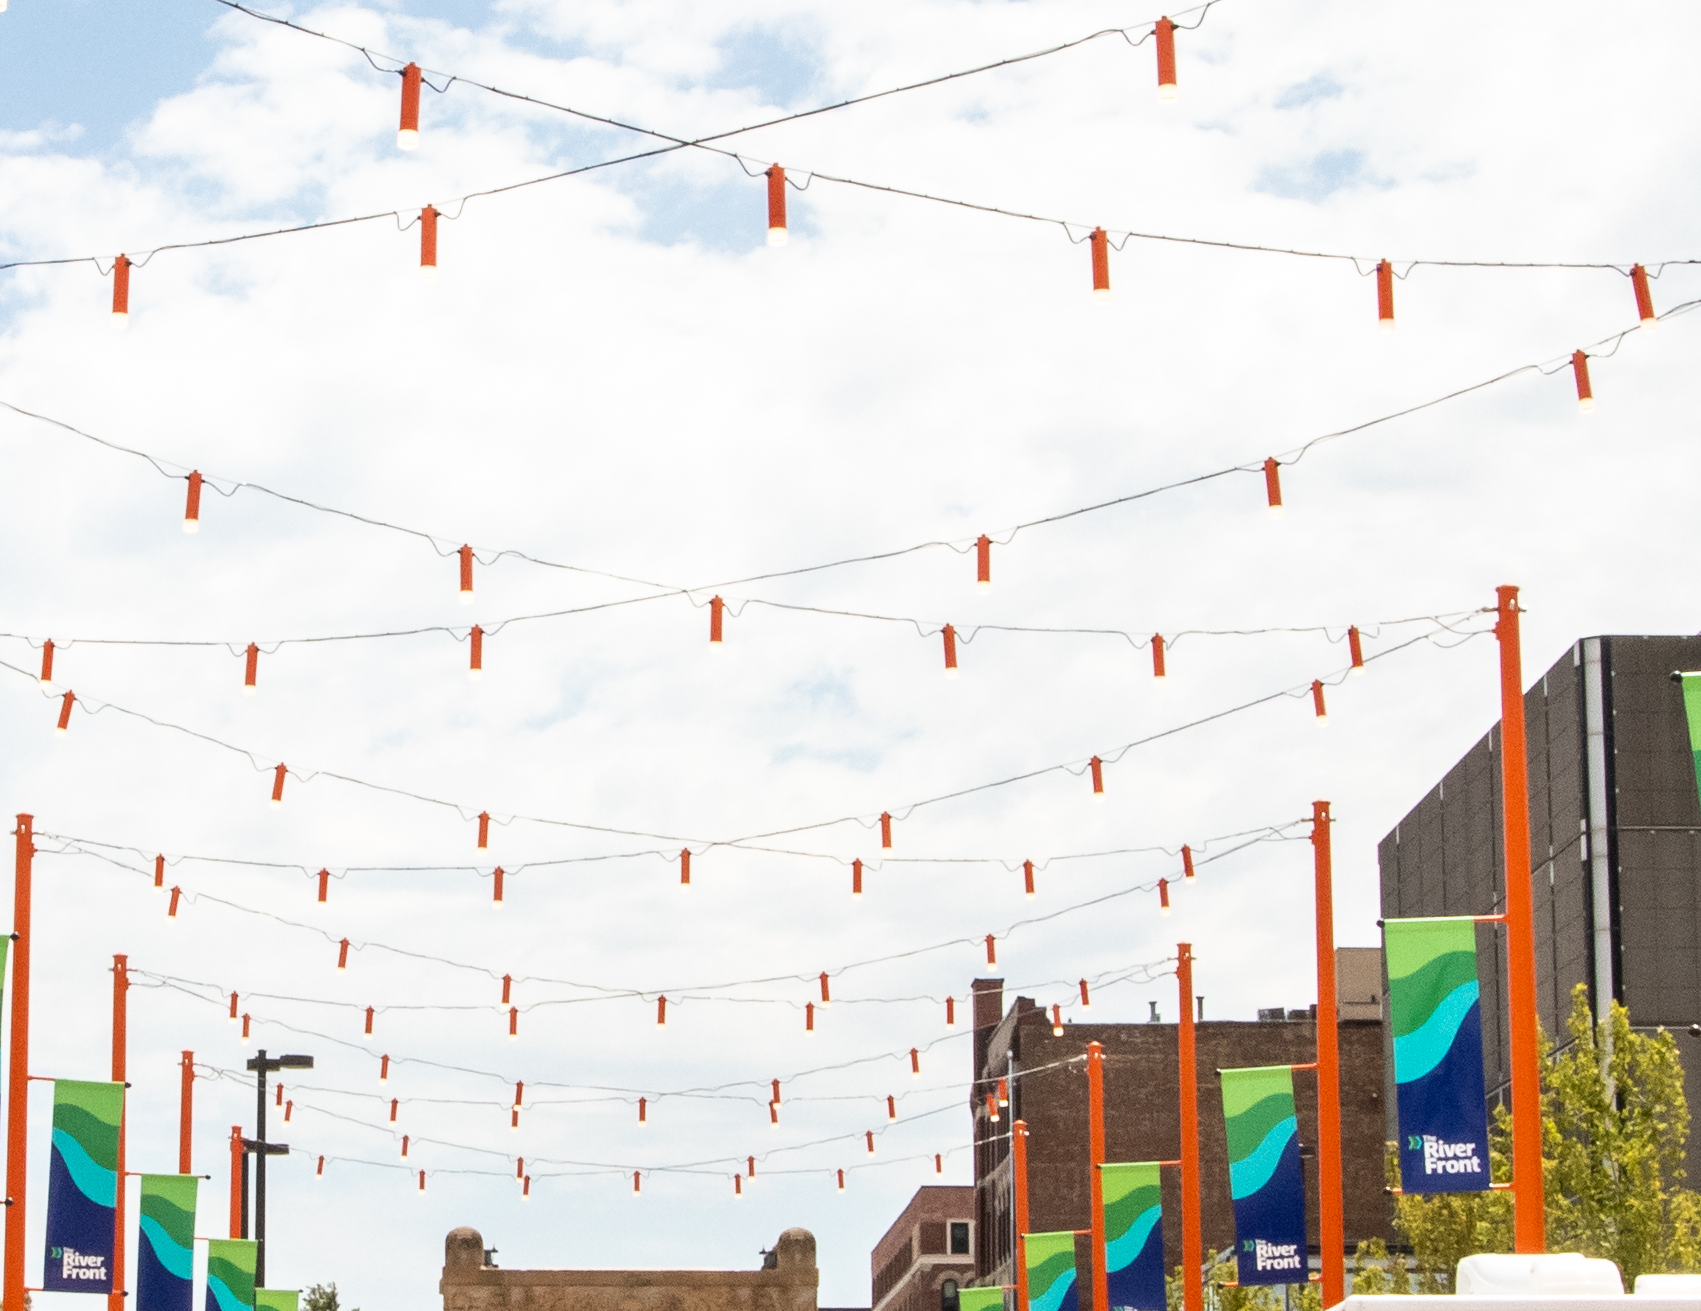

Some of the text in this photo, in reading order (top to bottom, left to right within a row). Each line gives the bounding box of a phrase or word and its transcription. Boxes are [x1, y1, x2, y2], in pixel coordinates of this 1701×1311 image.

[1424, 1138, 1476, 1158] River
[1425, 1155, 1481, 1174] Front
[1256, 1242, 1297, 1258] River
[63, 1251, 104, 1267] River
[1256, 1255, 1301, 1271] Front
[63, 1265, 106, 1280] Front
